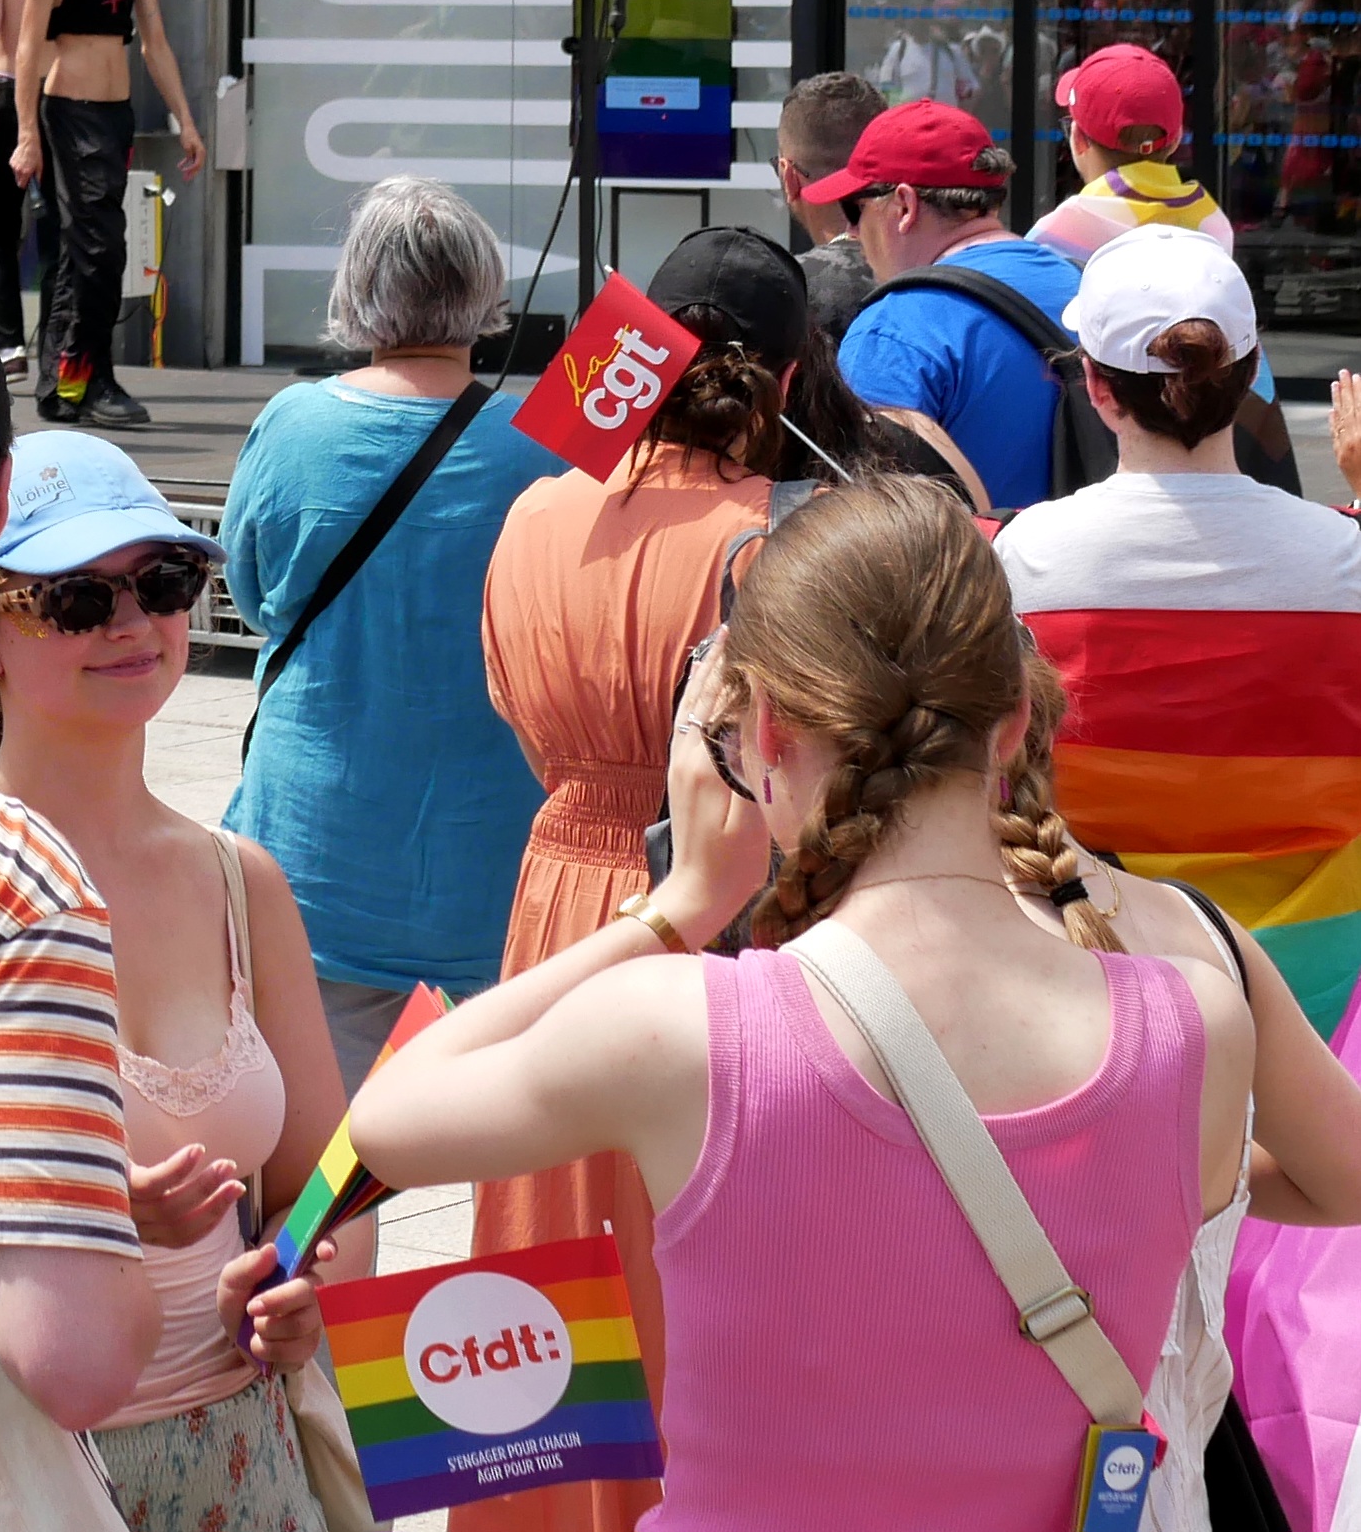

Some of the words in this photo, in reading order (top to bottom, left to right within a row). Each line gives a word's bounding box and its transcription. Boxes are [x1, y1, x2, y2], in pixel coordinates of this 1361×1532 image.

[563, 323, 630, 408] la
[583, 328, 670, 430] cgt
[16, 479, 67, 507] Löhne
[447, 1446, 506, 1472] S'ENGAGER
[508, 1439, 538, 1459] POUR
[540, 1432, 581, 1452] CHACUN
[478, 1467, 504, 1484] AGIR
[505, 1460, 534, 1477] POUR
[536, 1454, 563, 1471] TOUS
